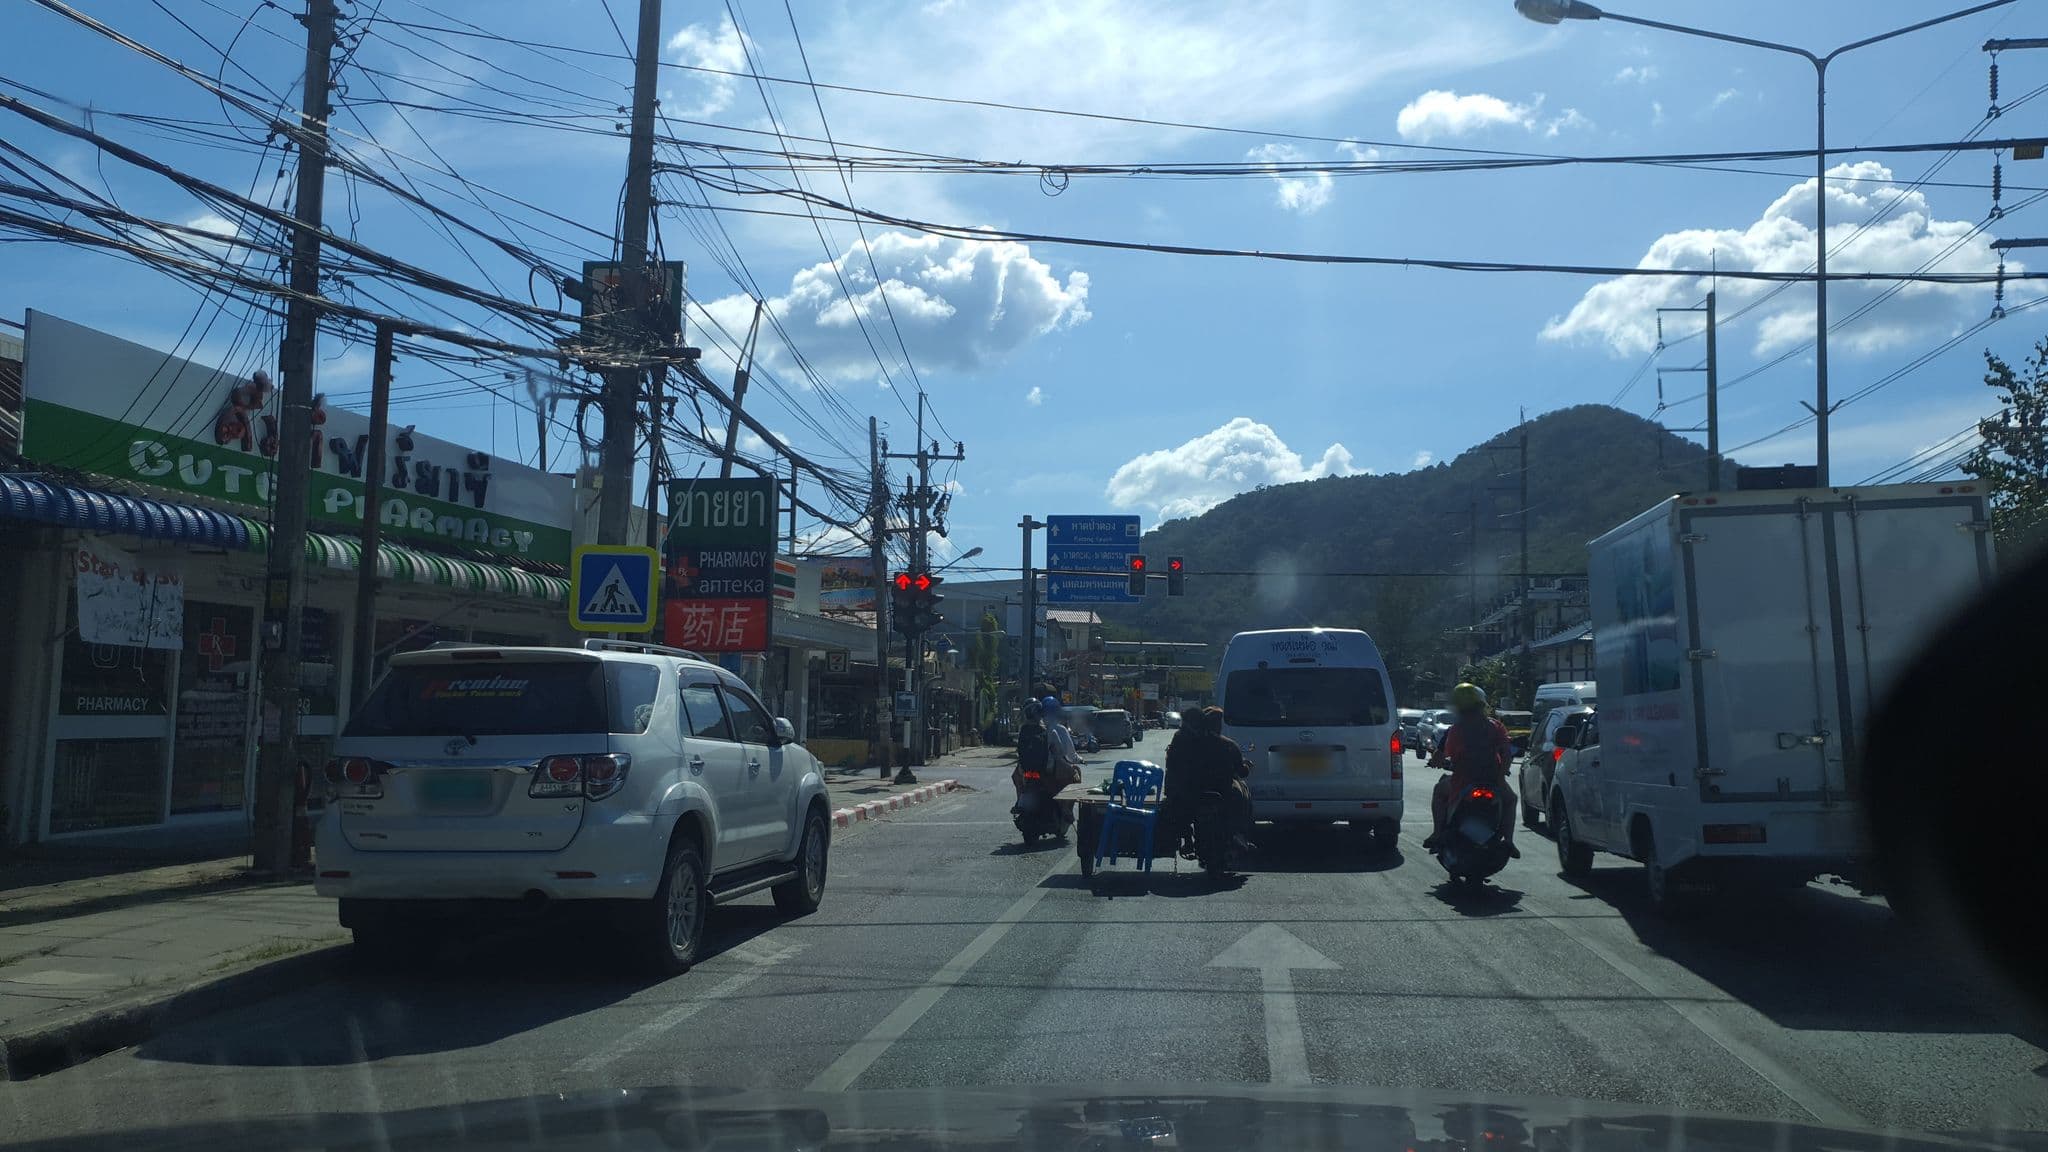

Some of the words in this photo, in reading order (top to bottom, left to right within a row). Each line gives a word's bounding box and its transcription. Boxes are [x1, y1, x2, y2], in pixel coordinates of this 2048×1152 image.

[699, 551, 767, 569] PHARMACY
[699, 579, 764, 593] аптека
[682, 602, 751, 648] 药店
[76, 696, 149, 713] PHARMACY
